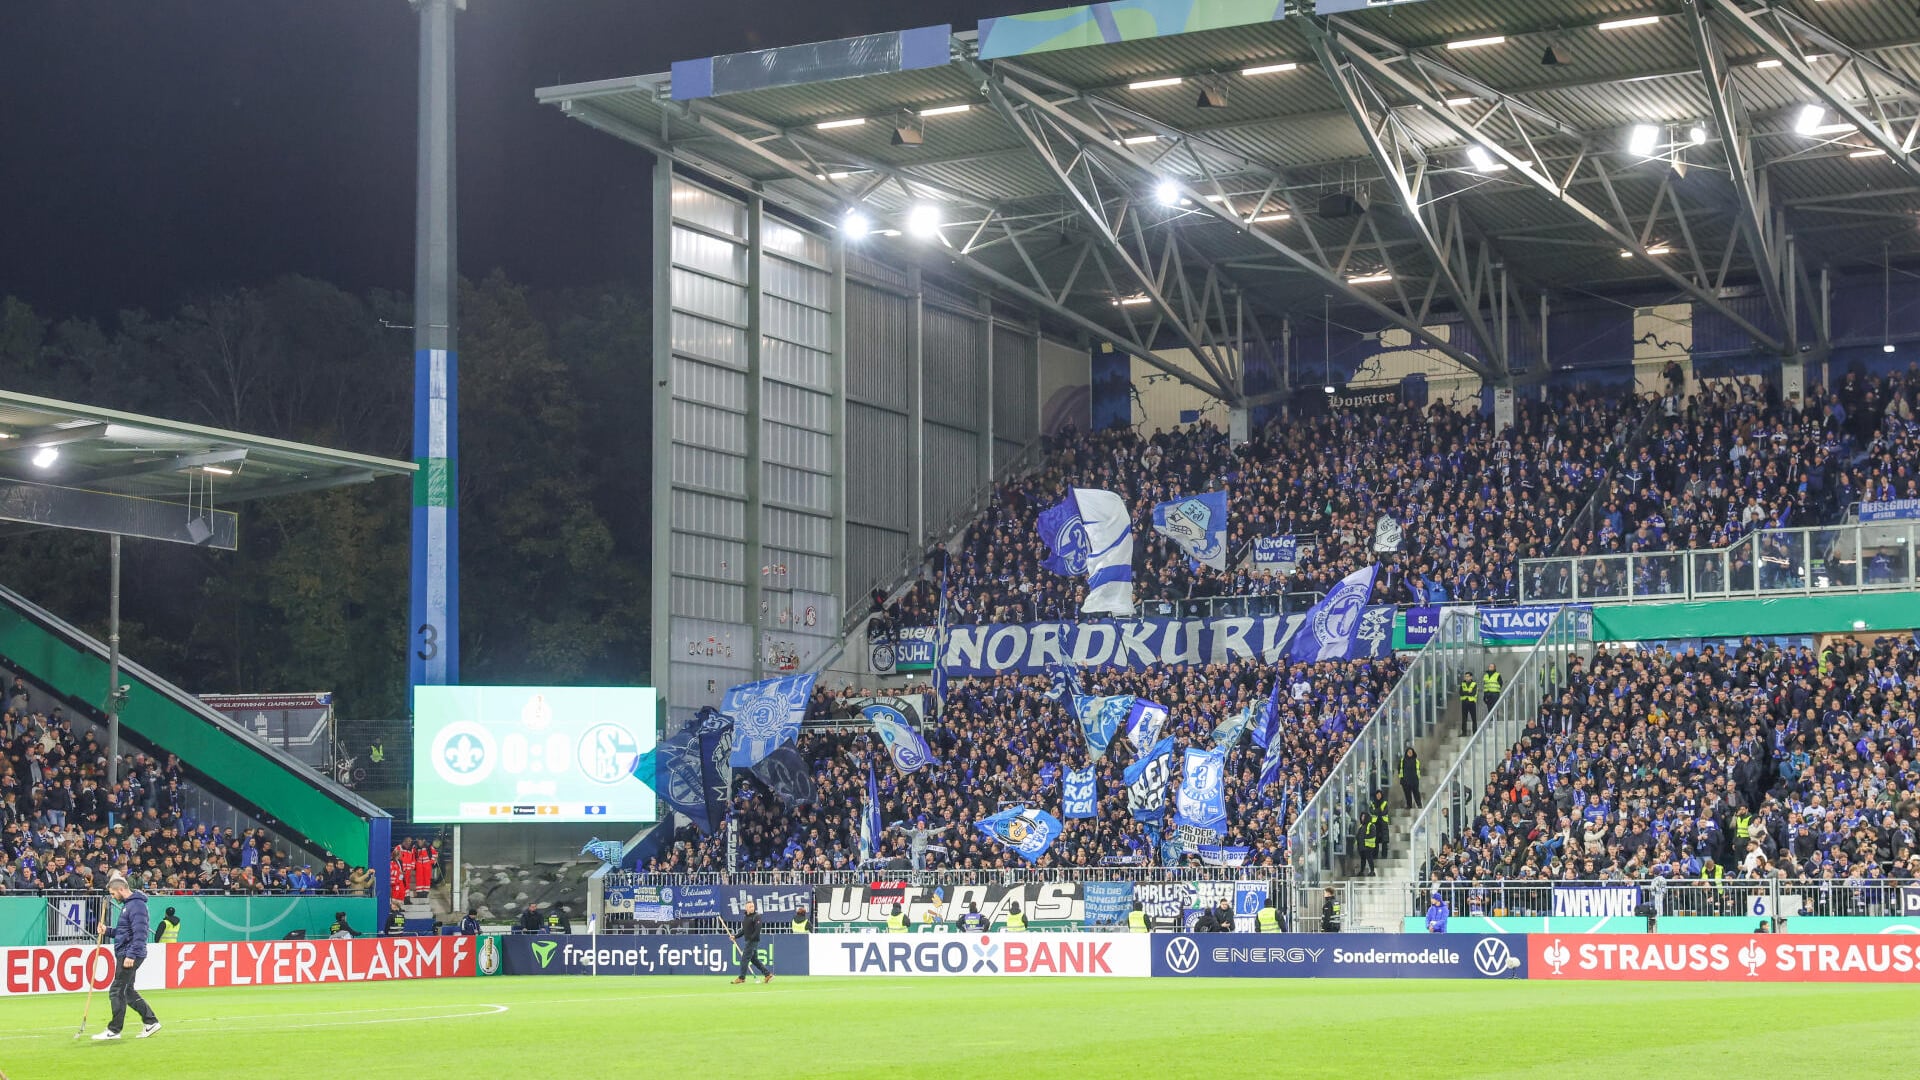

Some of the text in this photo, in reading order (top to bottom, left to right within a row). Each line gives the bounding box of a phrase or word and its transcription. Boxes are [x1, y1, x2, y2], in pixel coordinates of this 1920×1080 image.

[417, 624, 437, 660] 3
[898, 644, 930, 662] SUHL
[947, 612, 1306, 670] NORDKURV
[1753, 897, 1765, 915] 6
[208, 938, 442, 985] FLYERALARM
[563, 943, 774, 972] freenet, fertig, ls!
[1213, 947, 1325, 963] ENERGY
[1333, 949, 1460, 965] Sondermodelle
[1579, 943, 1730, 971] STRAUSS
[7, 948, 116, 994] ERGO
